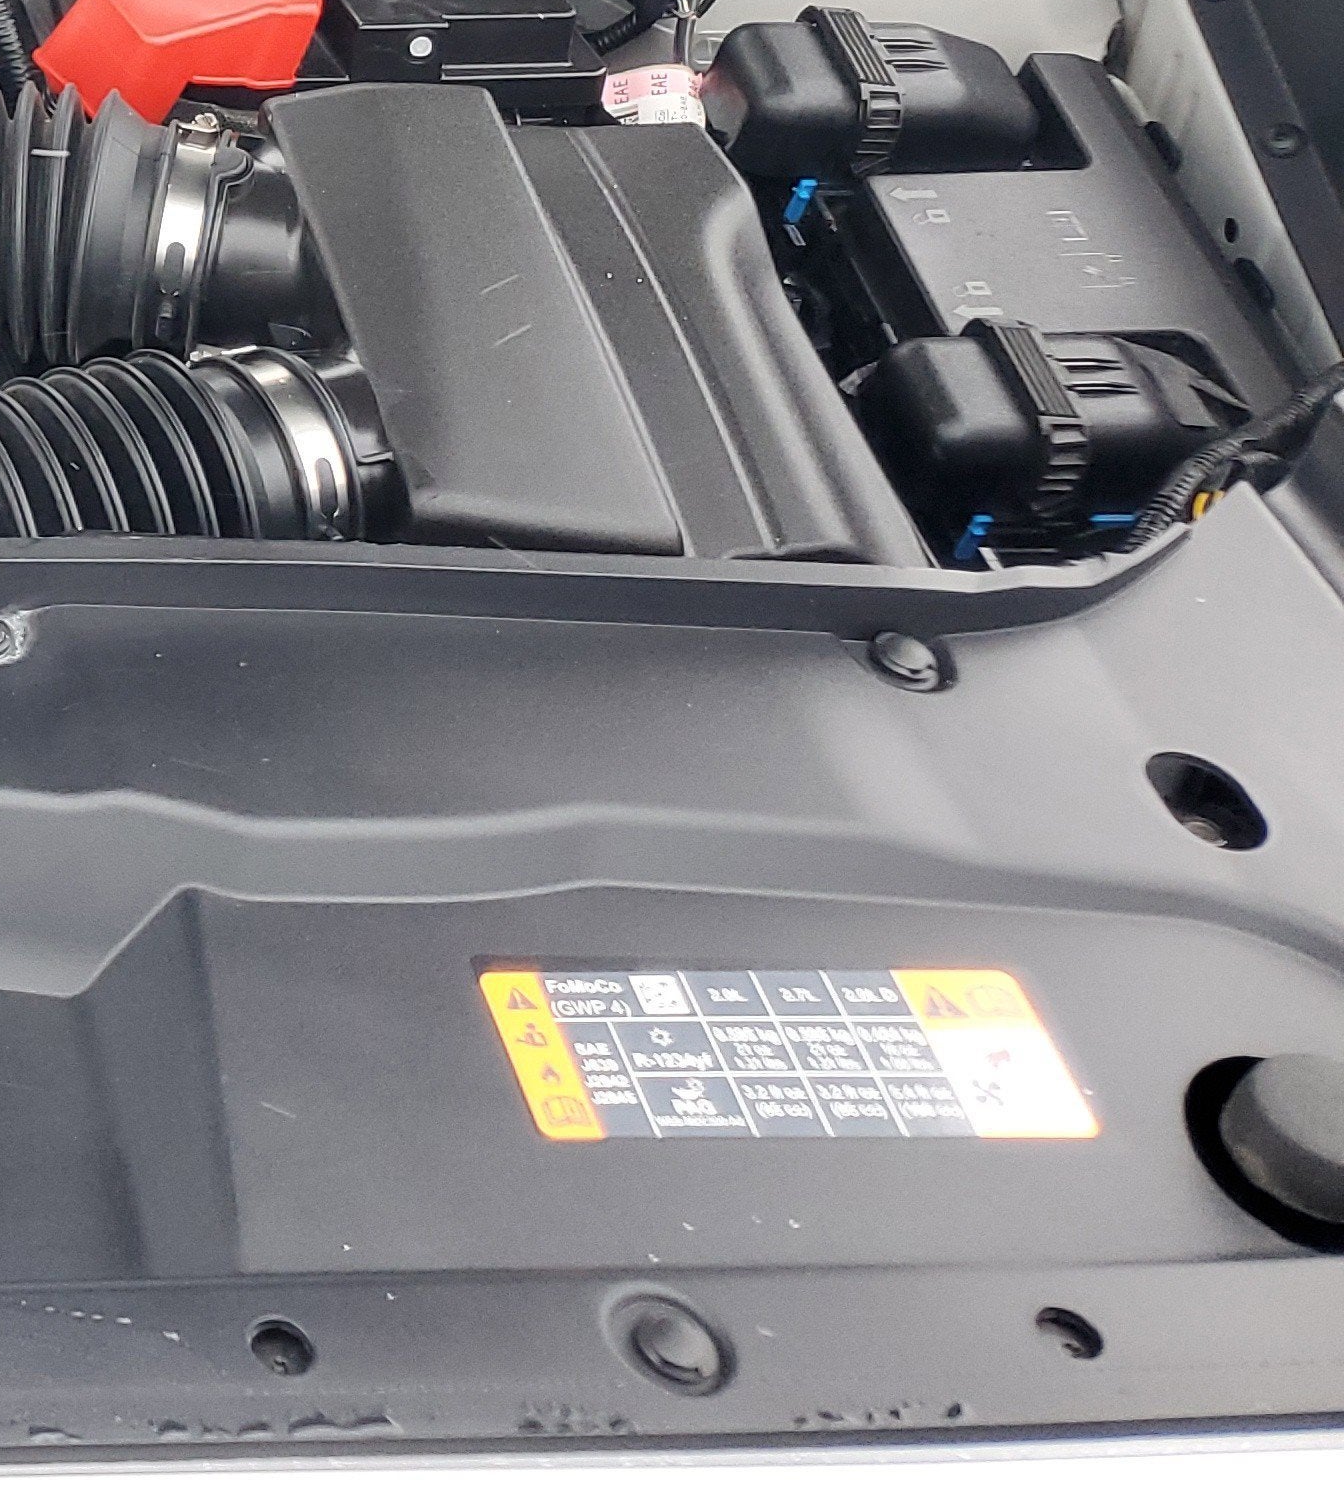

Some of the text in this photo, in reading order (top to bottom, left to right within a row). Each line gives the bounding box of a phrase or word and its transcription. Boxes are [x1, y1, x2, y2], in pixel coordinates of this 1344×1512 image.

[612, 77, 630, 106] EAE
[650, 71, 669, 97] EAE
[544, 978, 623, 994] FoMoCo
[550, 999, 632, 1018] (GWP 4)
